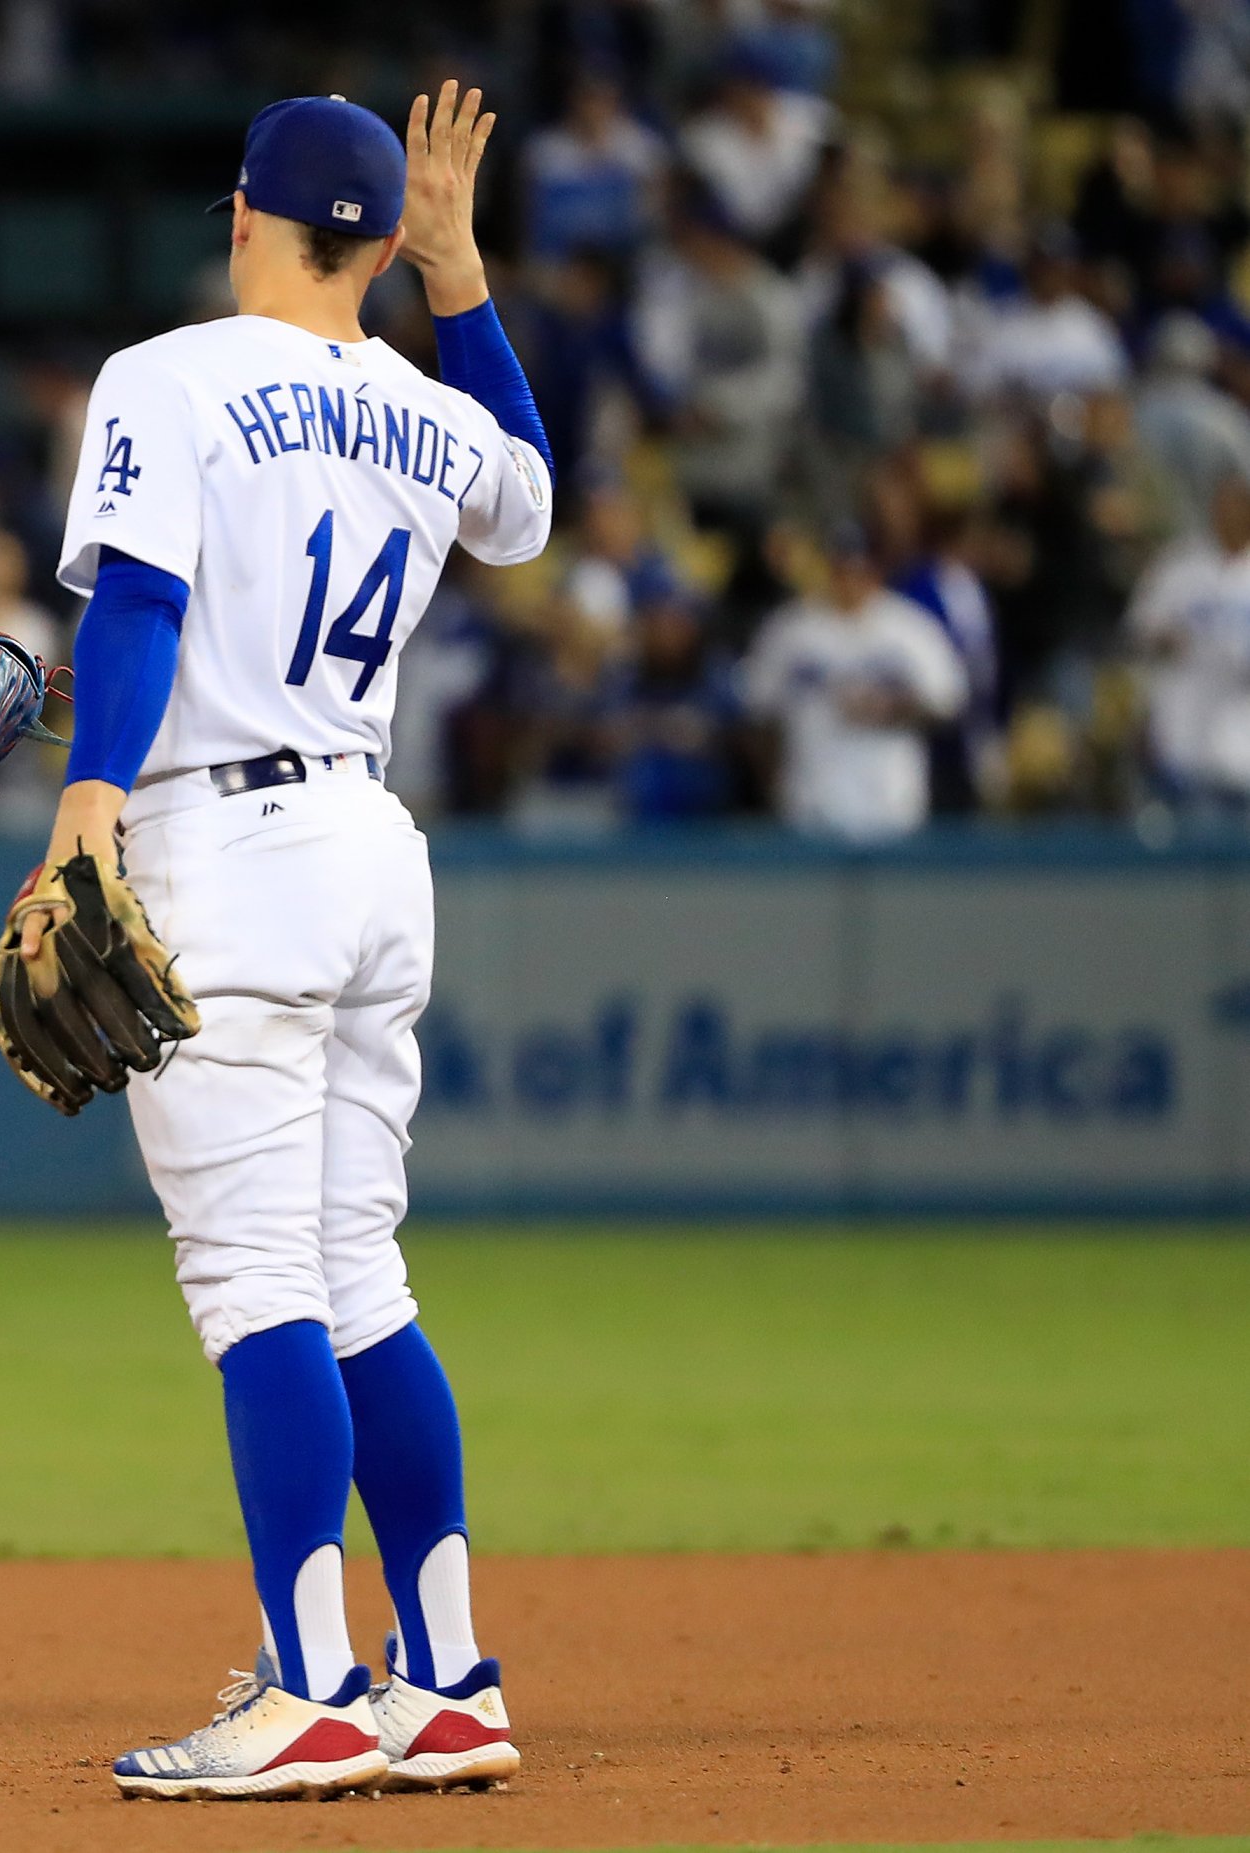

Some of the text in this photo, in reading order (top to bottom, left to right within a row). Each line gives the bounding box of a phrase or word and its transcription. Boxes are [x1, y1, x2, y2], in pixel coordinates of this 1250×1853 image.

[96, 417, 142, 496] LA
[225, 383, 484, 511] HERNÁNDEZ
[285, 510, 411, 701] 14
[665, 994, 1174, 1113] America
